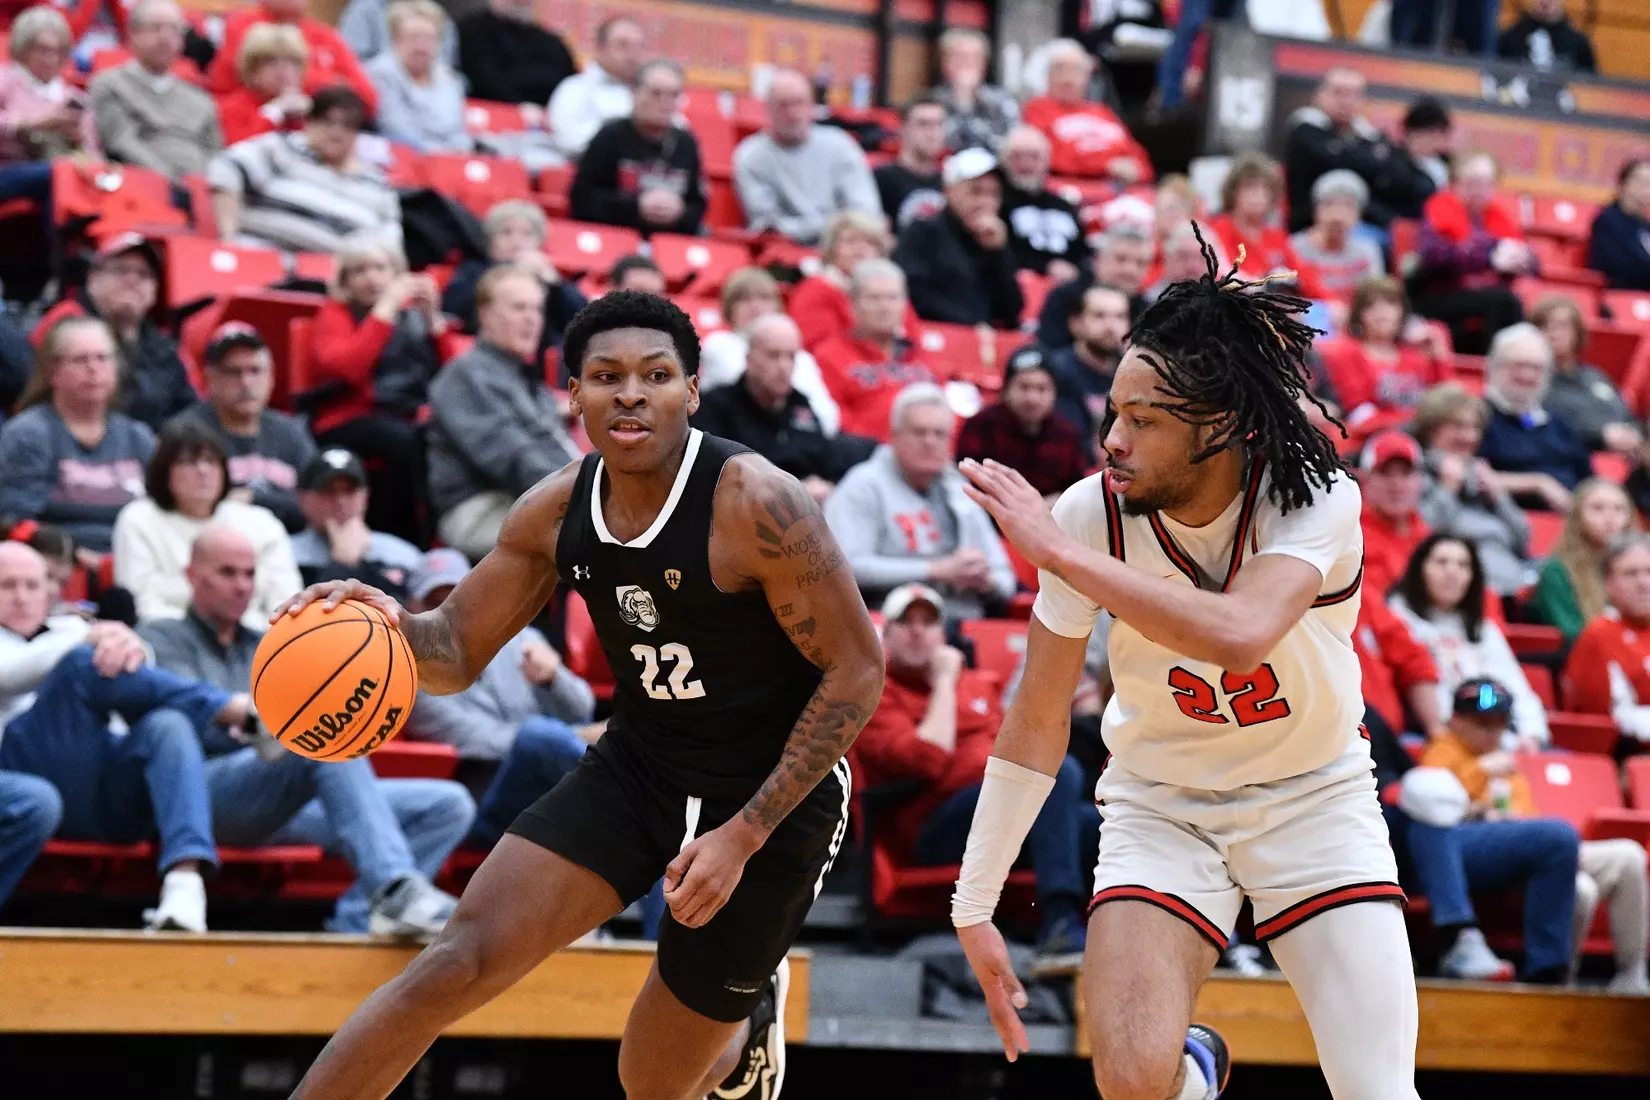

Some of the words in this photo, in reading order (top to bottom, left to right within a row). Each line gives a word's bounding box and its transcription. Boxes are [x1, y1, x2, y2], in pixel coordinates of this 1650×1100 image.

[630, 642, 706, 700] 22
[1168, 663, 1291, 727] 22
[290, 677, 378, 753] Wilson
